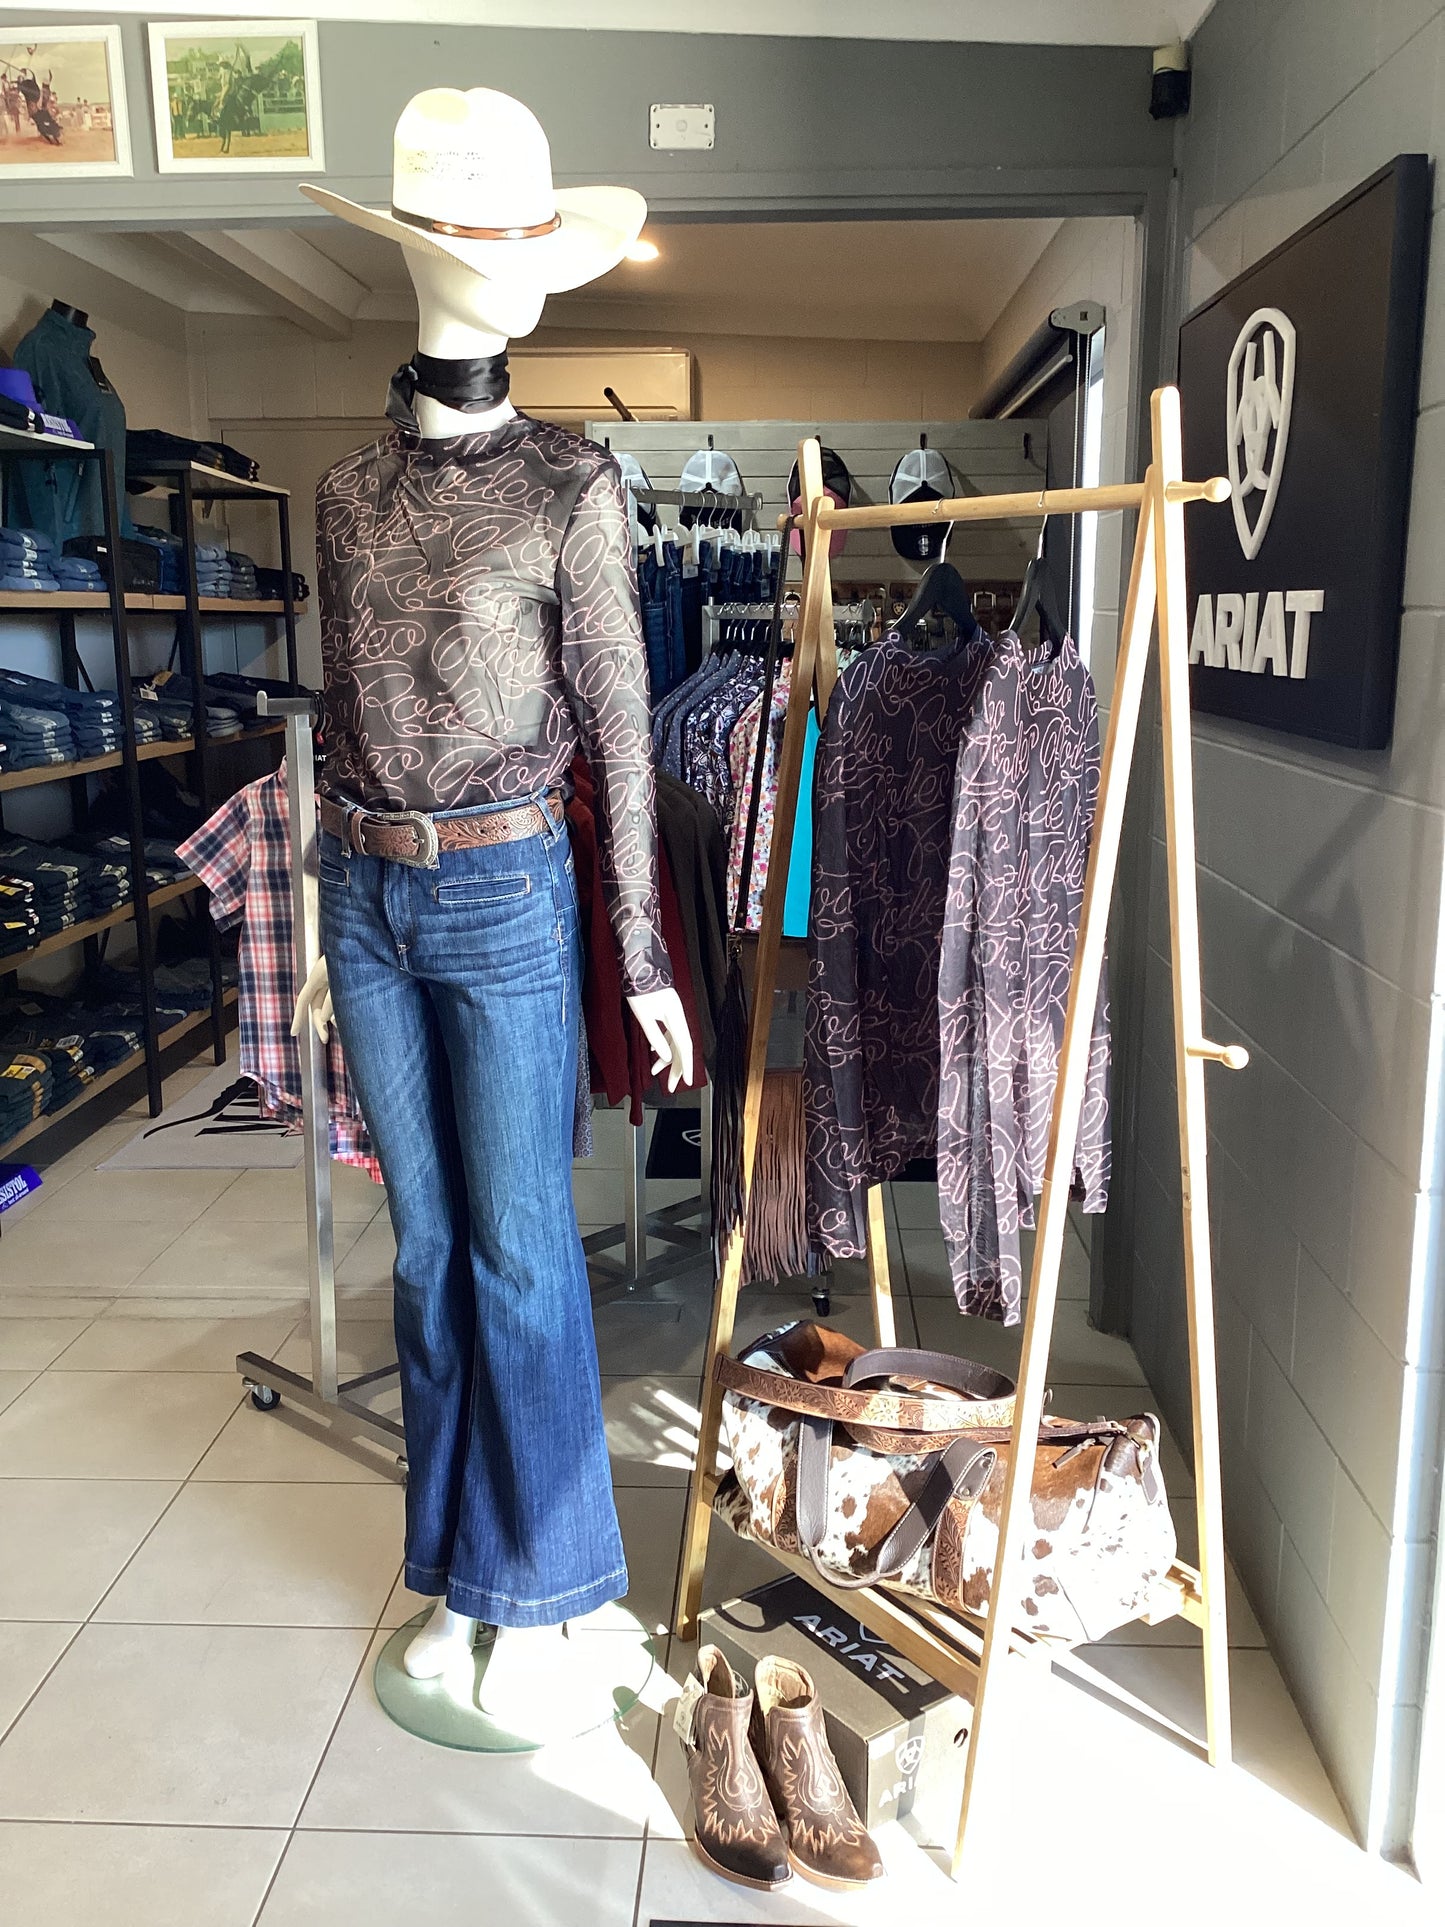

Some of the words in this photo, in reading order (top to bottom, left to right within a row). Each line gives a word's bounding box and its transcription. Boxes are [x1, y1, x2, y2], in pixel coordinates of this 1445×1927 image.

[1189, 589, 1325, 680] ARIAT
[314, 754, 327, 762] IAT
[0, 1174, 28, 1205] SISTOL
[792, 1614, 906, 1680] ARIAT
[878, 1776, 914, 1809] ARI
